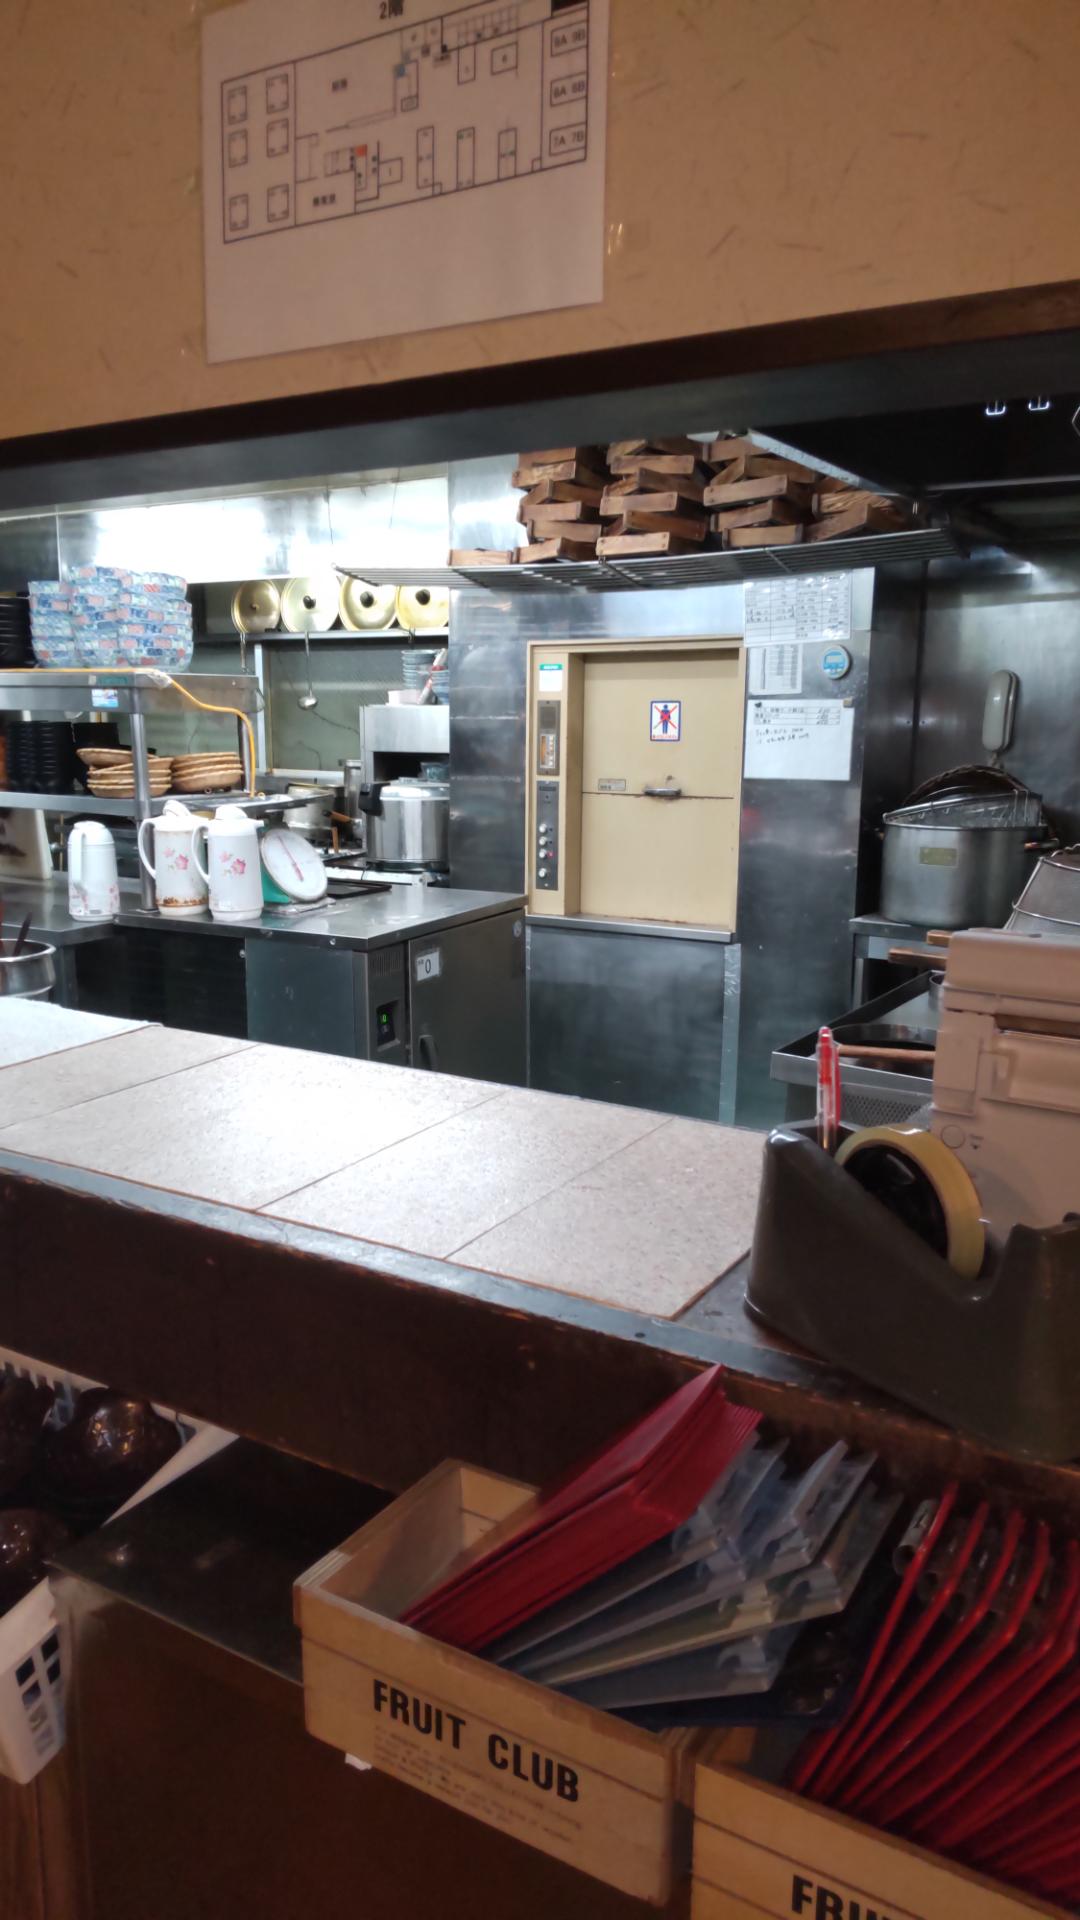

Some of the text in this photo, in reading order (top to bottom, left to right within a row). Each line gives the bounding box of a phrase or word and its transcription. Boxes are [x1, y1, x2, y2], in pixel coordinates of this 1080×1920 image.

[373, 1678, 467, 1750] FRUIT
[487, 1733, 579, 1802] CLUB
[792, 1874, 891, 1920] FR
